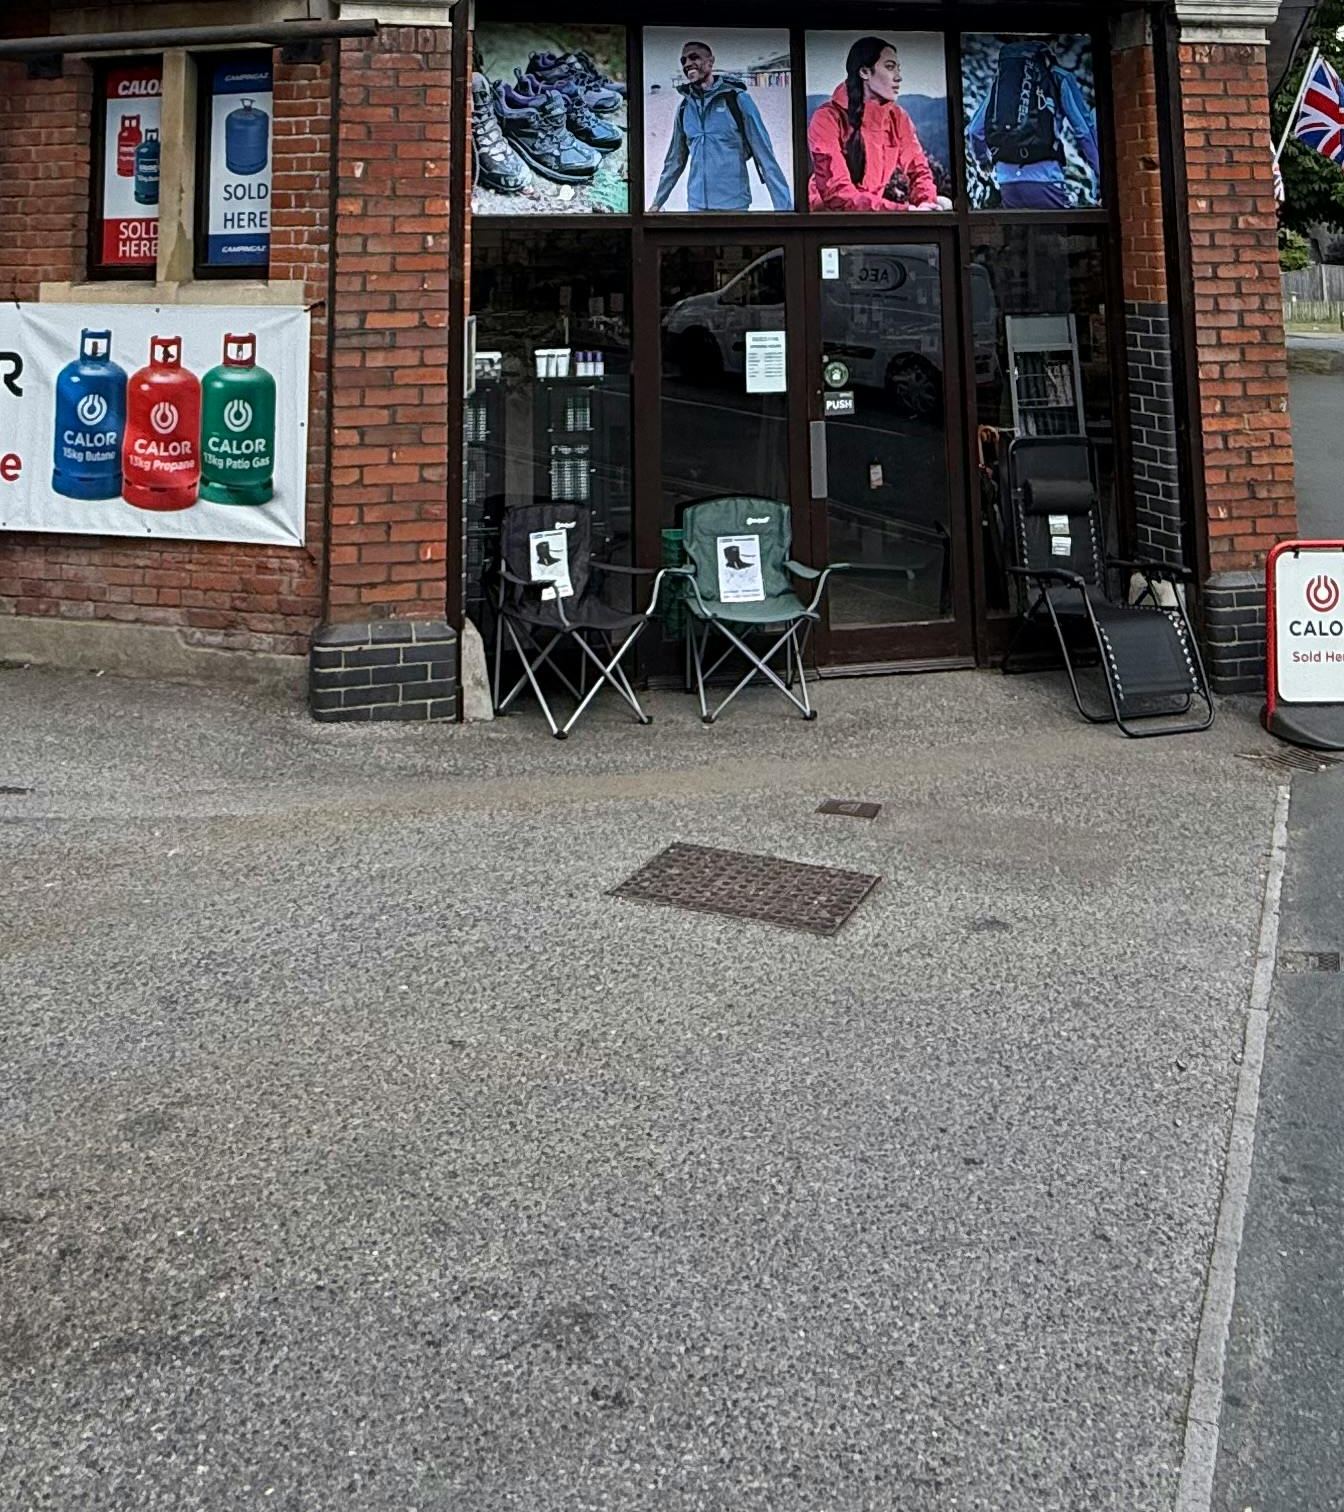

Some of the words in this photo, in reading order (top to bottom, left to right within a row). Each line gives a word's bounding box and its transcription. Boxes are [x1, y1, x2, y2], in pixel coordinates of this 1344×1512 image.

[117, 78, 162, 96] CALO
[223, 183, 269, 201] SOLD
[223, 211, 269, 229] HERE
[118, 221, 160, 239] SOLD
[118, 240, 160, 257] HERE
[826, 399, 853, 410] PUSH
[63, 430, 117, 448] CALOR
[134, 439, 192, 456] CALOR
[208, 436, 267, 455] CALOR
[63, 446, 84, 462] 15kg
[226, 457, 250, 469] Patio
[252, 456, 270, 468] Gas
[153, 459, 195, 472] Propane
[1293, 651, 1322, 663] Sold
